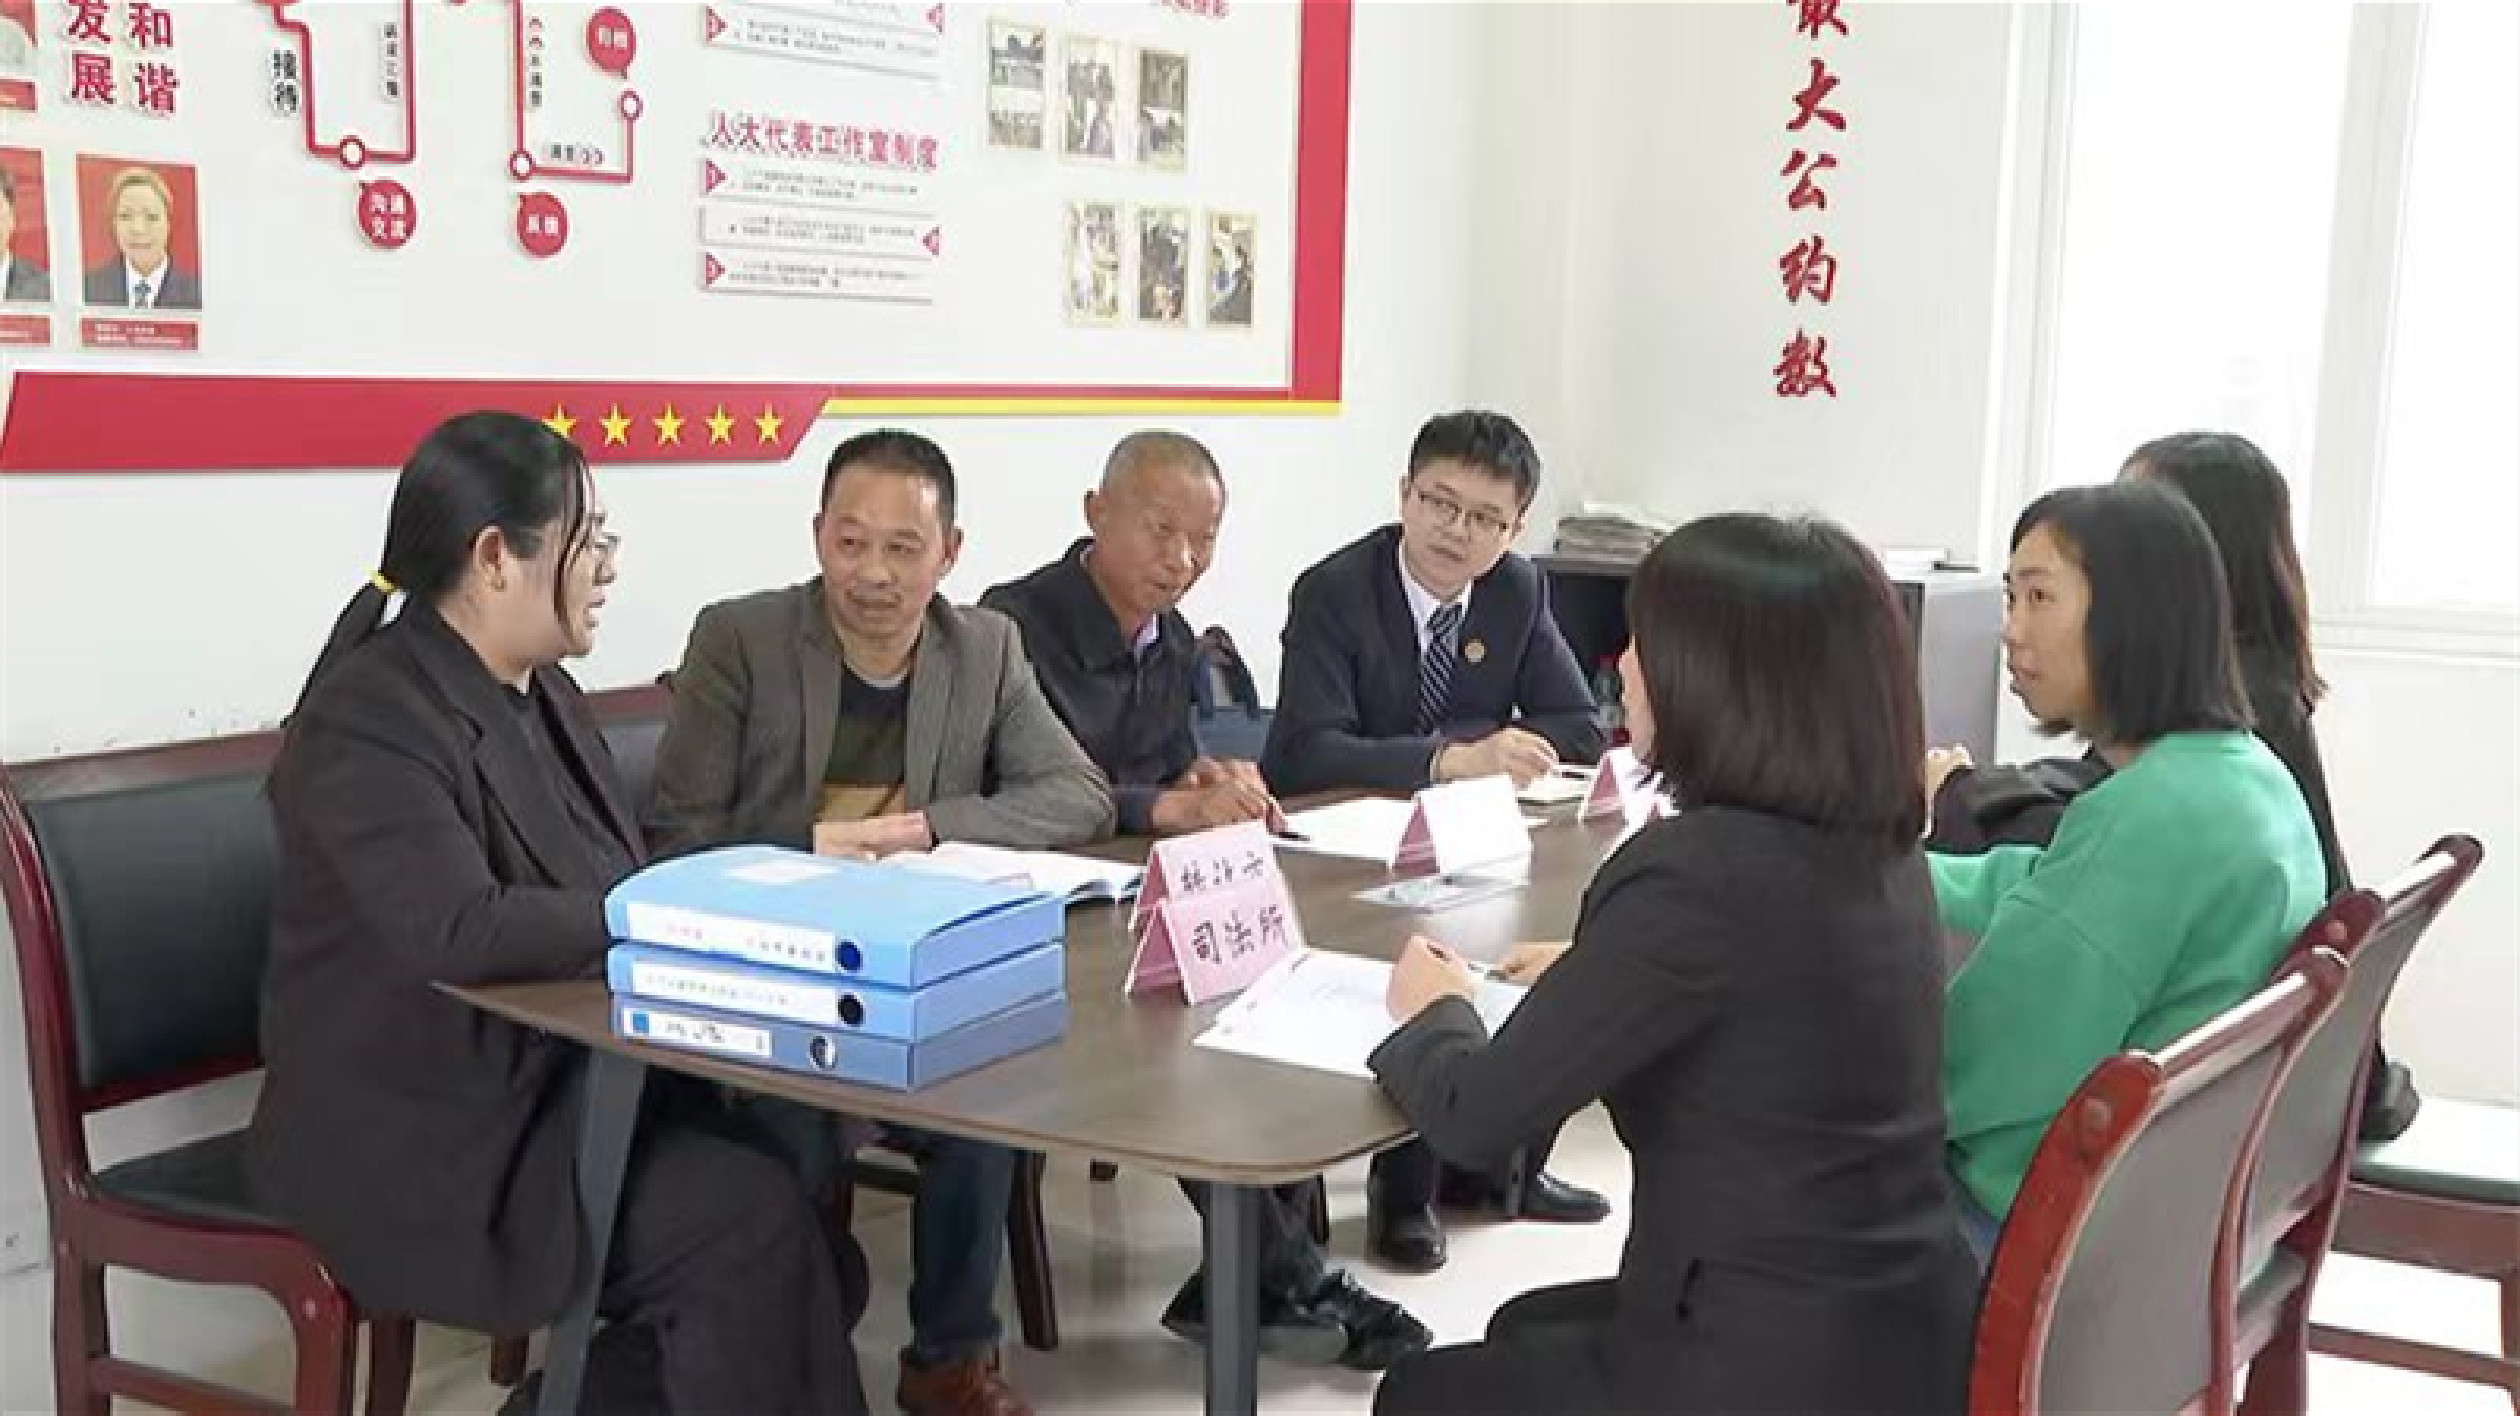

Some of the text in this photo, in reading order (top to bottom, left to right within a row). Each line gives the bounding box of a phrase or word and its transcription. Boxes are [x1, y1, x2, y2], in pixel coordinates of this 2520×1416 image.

[68, 0, 116, 105] 发展
[129, 2, 180, 113] 和谐
[709, 111, 939, 170] 人大代表工作室制度
[1191, 904, 1288, 964] 司法所
